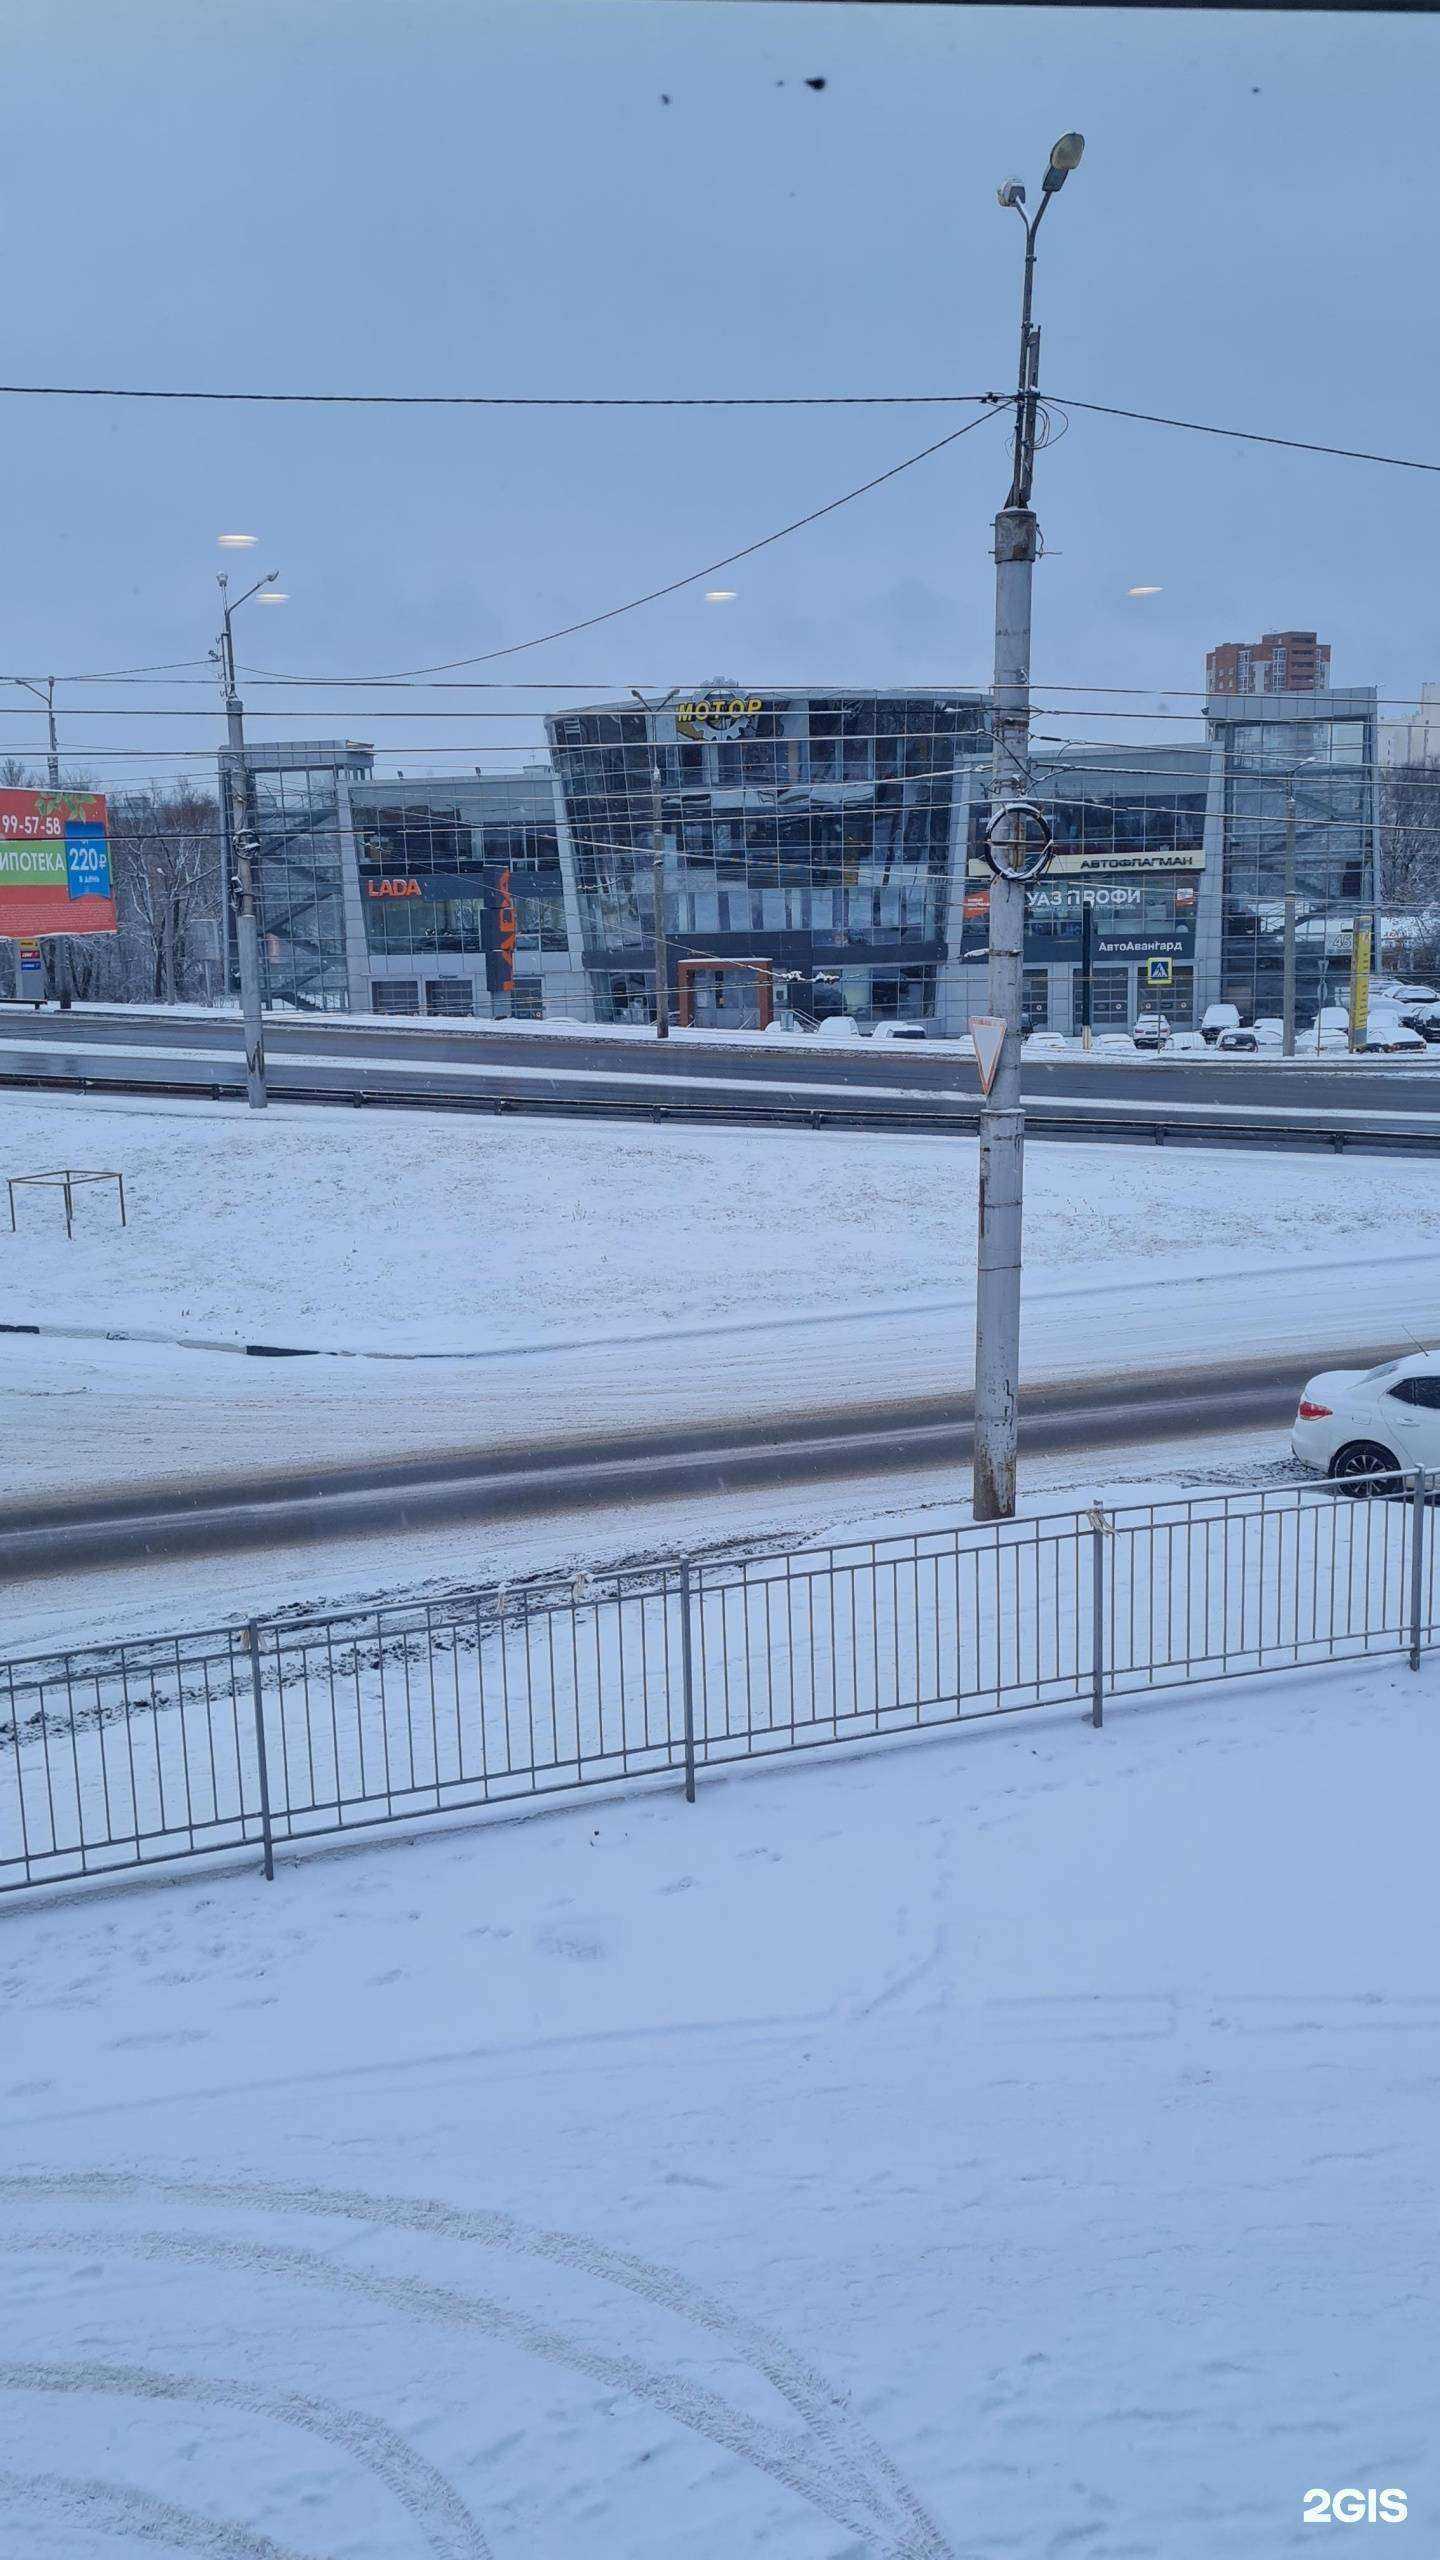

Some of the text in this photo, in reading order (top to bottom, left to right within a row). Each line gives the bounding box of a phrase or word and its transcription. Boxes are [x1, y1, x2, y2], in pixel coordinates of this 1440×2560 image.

[678, 698, 762, 721] МОТОР
[2, 815, 61, 834] 99-57-58
[0, 852, 65, 871] ИПОТЕКА
[1081, 856, 1193, 869] АВТОФЛАГМАН
[367, 878, 422, 897] LADA
[1026, 890, 1062, 906] УАЗ
[1098, 941, 1183, 952] АвтоАвангард
